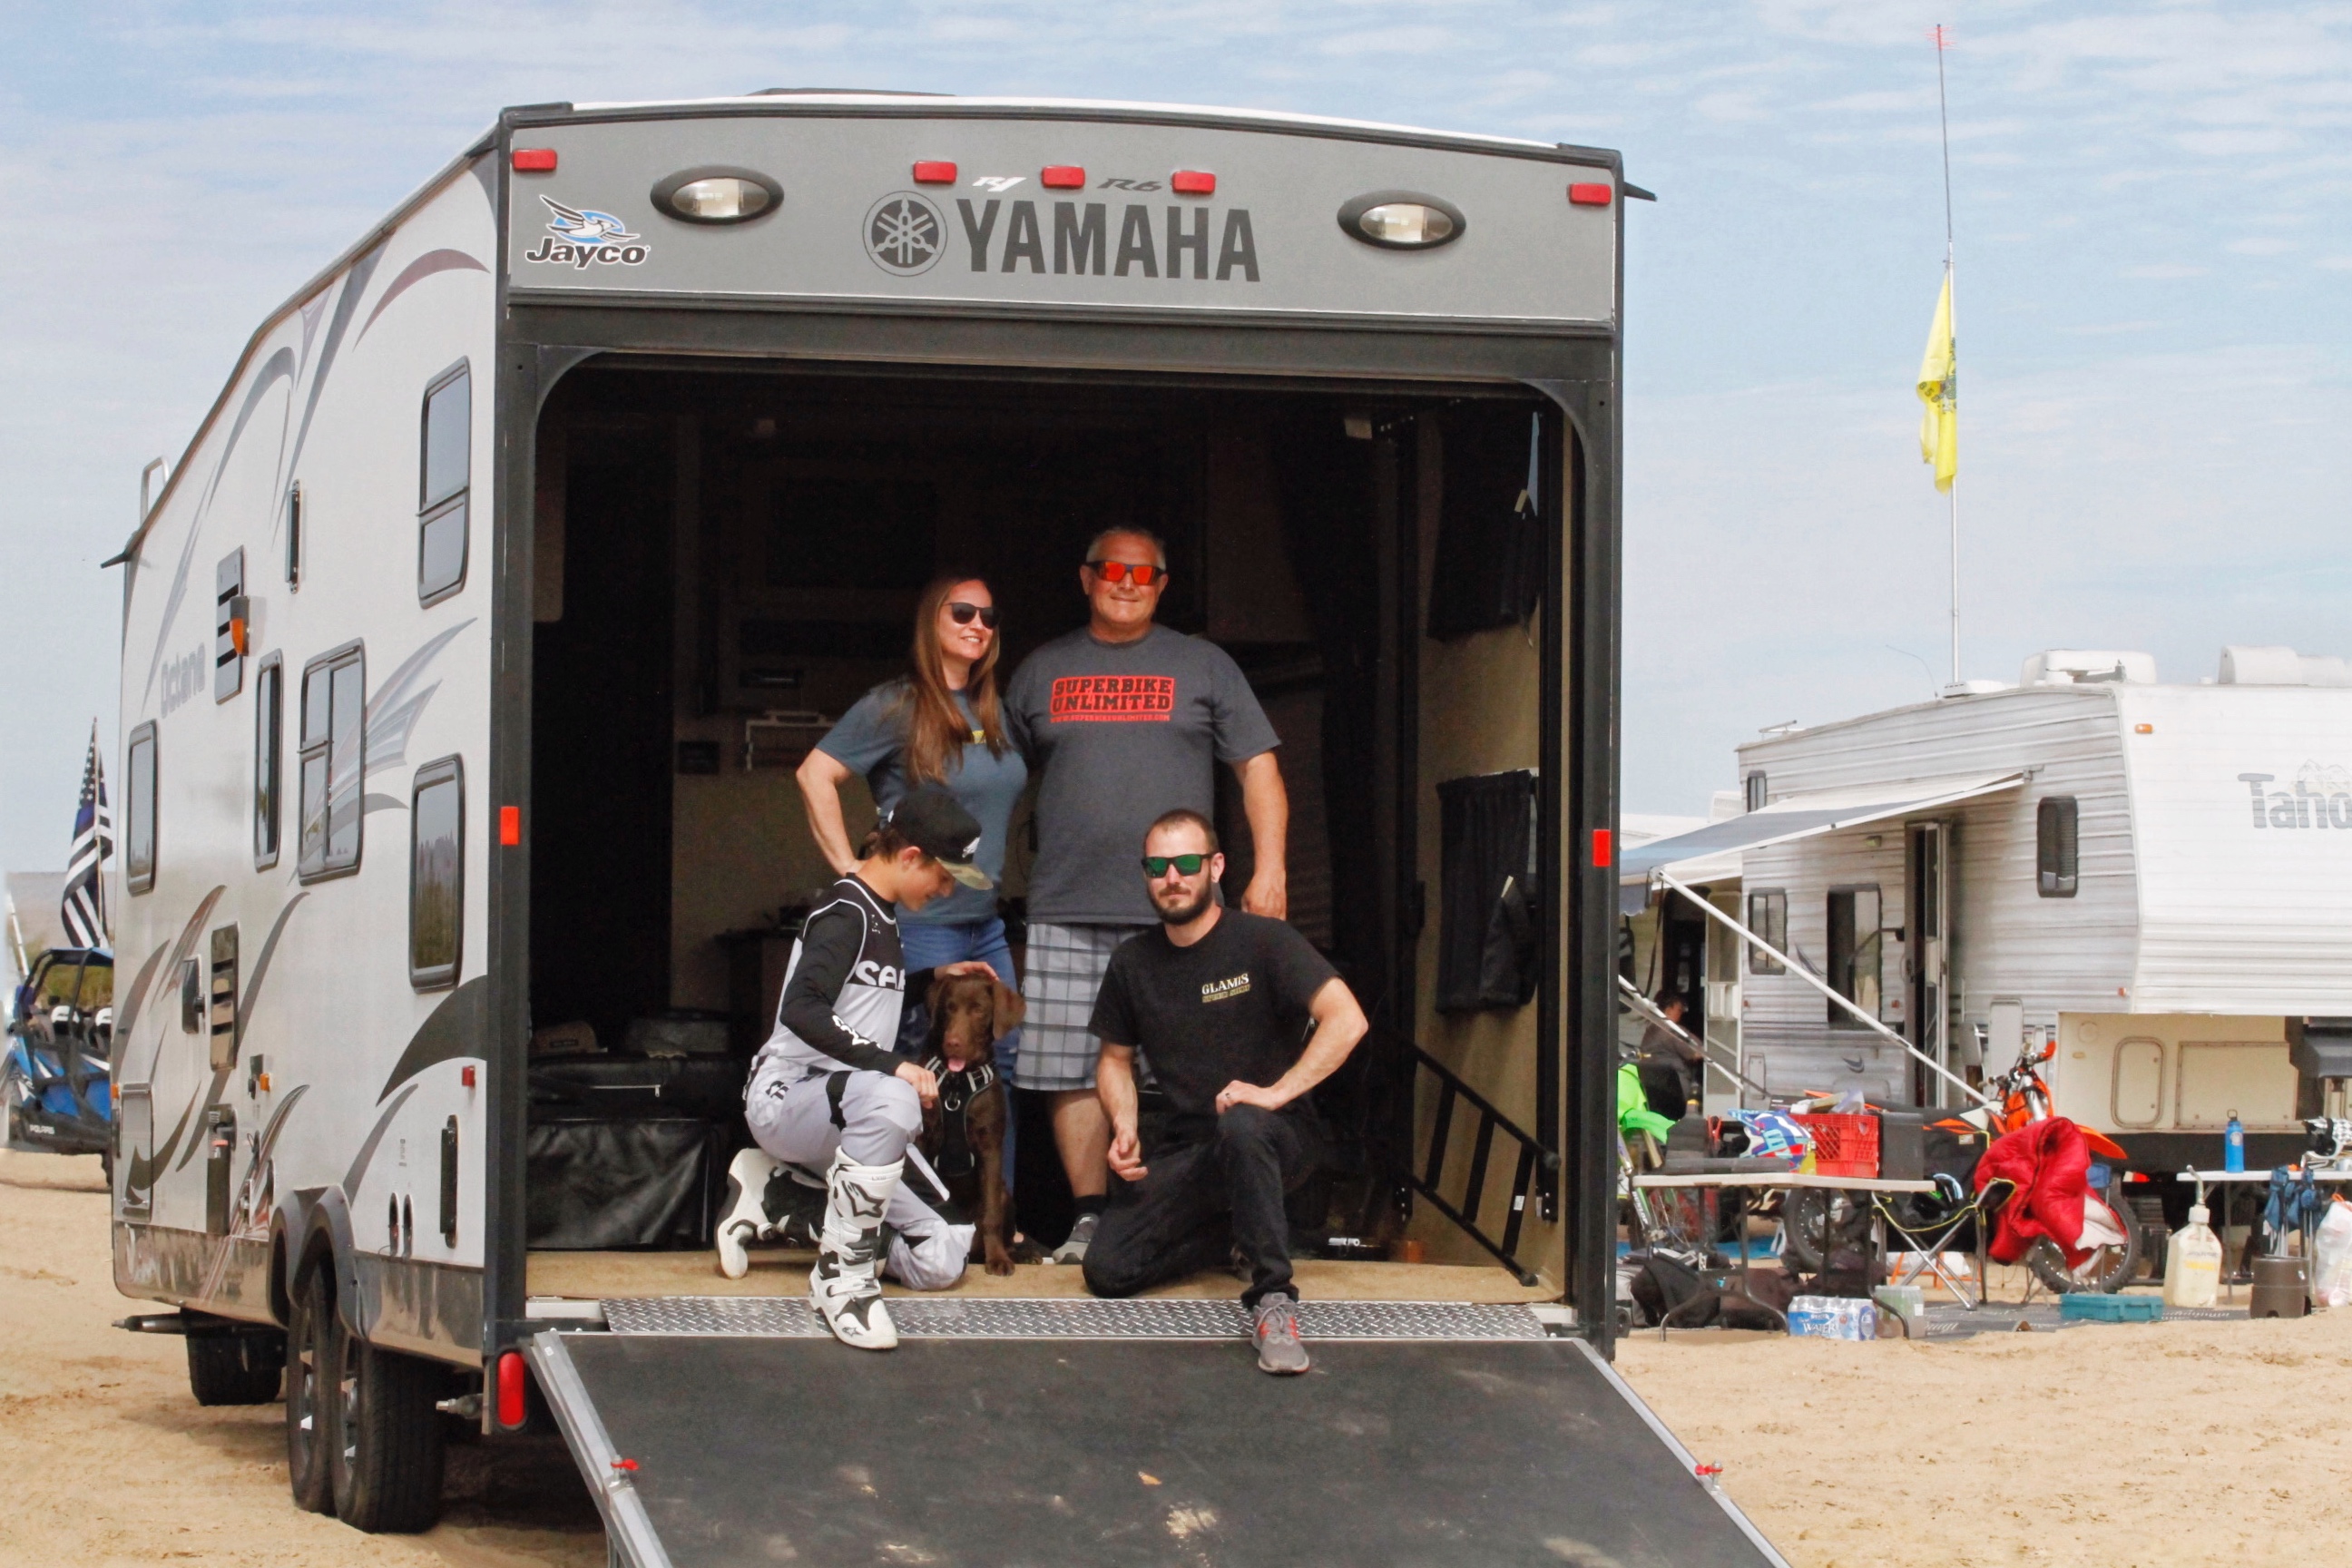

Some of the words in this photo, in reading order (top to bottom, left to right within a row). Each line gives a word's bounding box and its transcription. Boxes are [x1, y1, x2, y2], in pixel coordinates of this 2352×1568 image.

[1096, 178, 1163, 192] R6
[956, 198, 1261, 282] YAMAHA
[525, 237, 646, 270] Jayco
[1054, 677, 1171, 697] SUPERBIKE
[1052, 694, 1171, 713] UNLIMITED
[1201, 973, 1250, 995] GLAMIS
